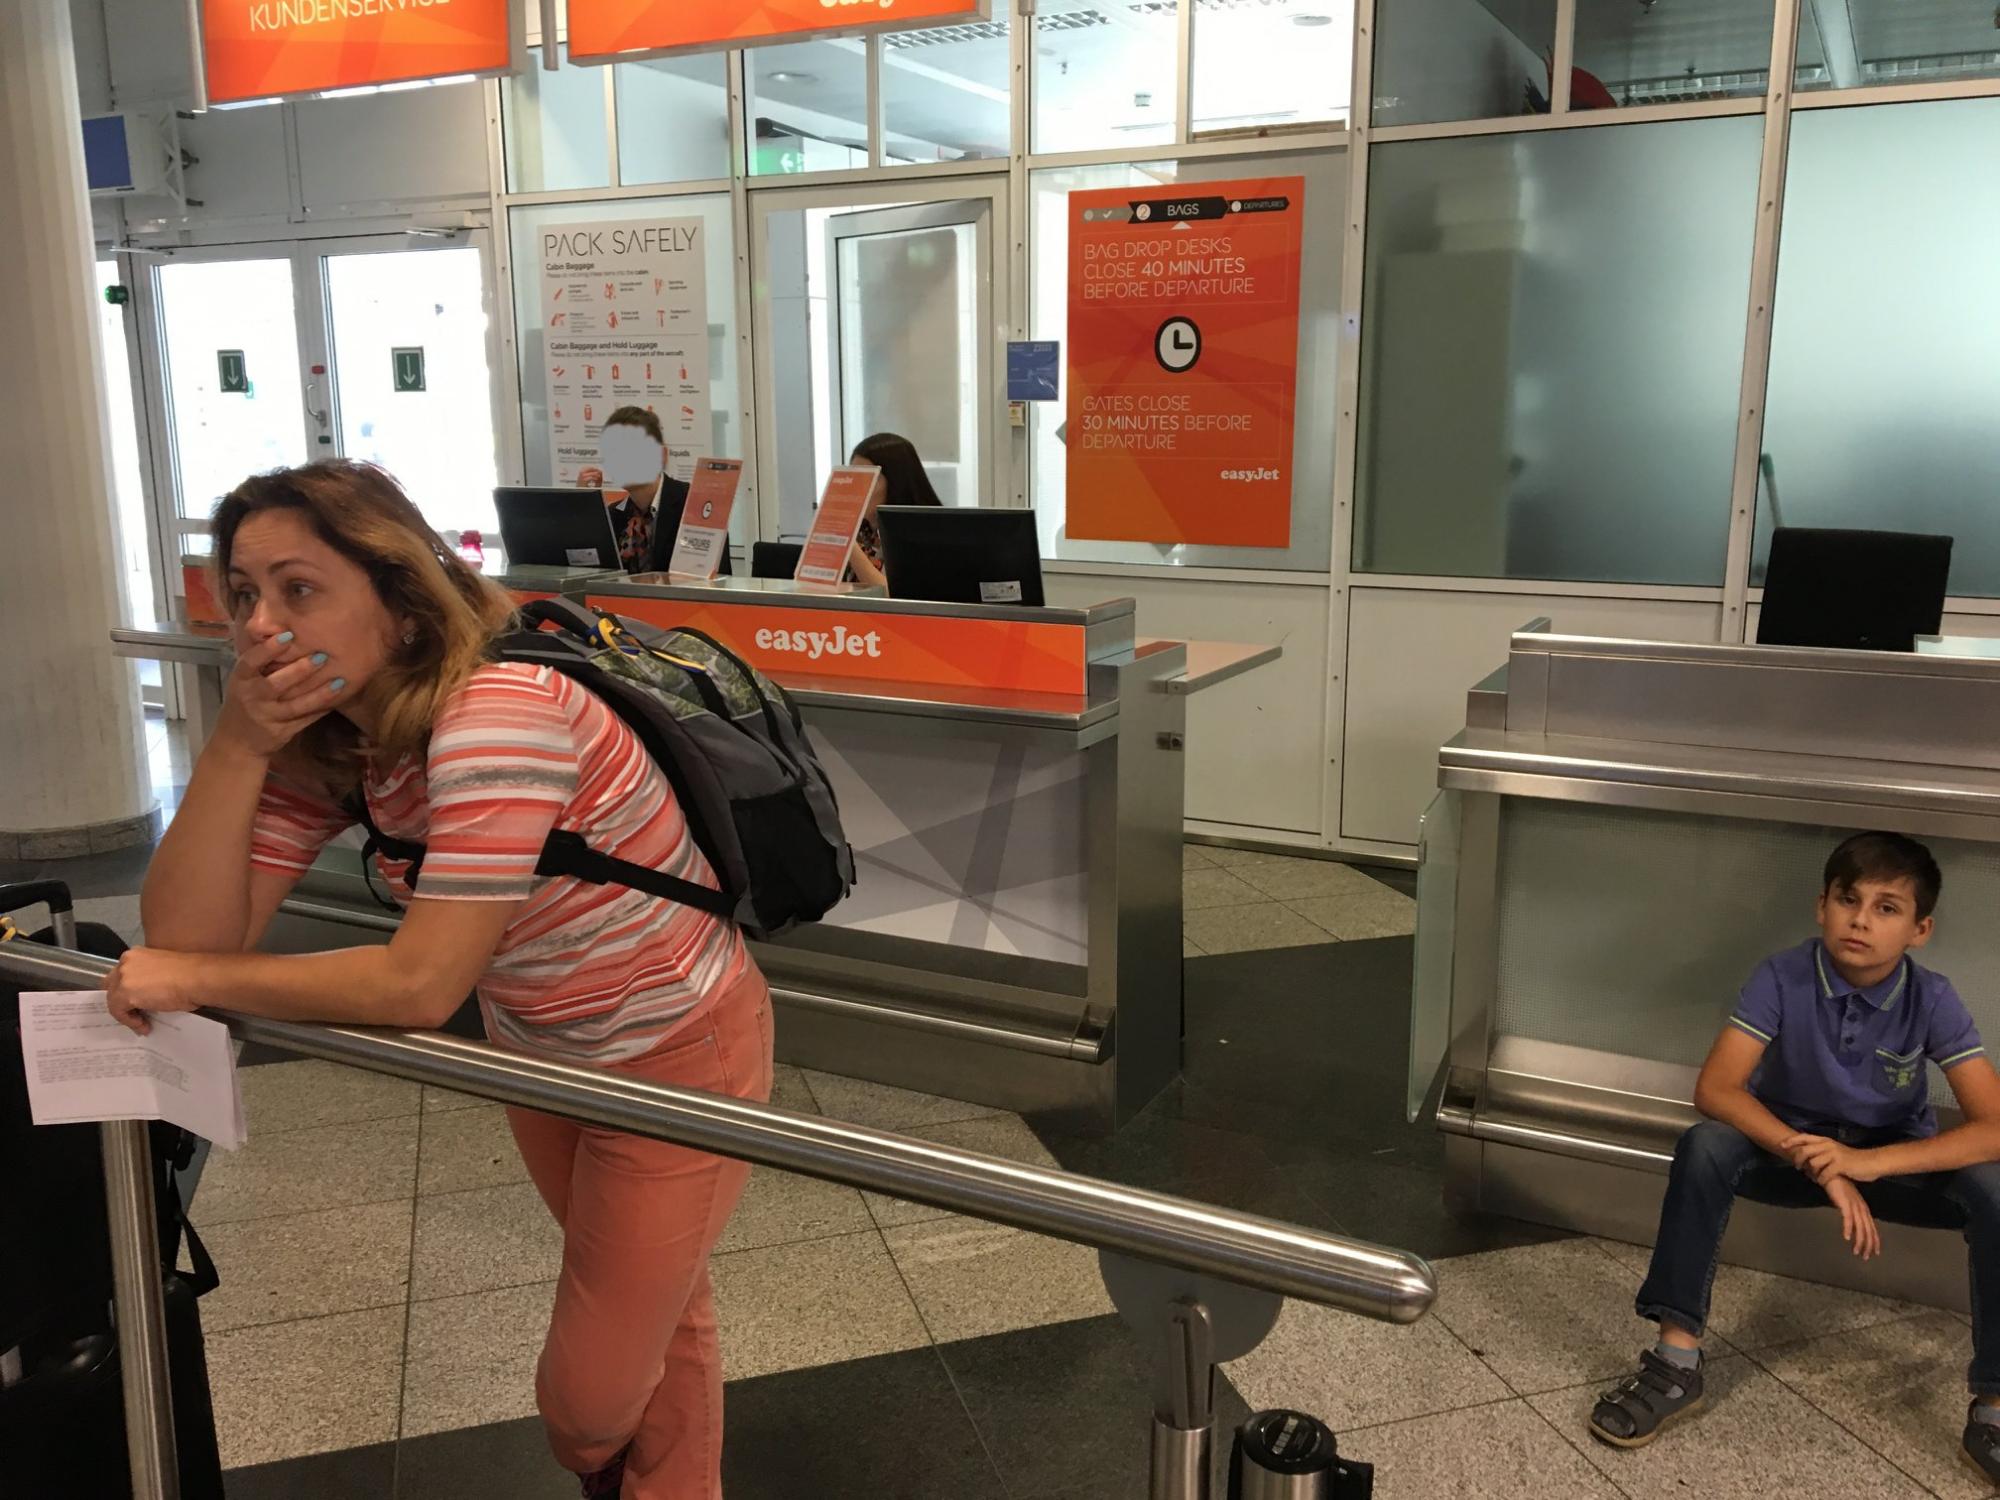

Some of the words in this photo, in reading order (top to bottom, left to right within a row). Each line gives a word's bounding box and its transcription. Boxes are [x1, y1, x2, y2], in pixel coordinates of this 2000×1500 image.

[249, 0, 451, 32] KUNDENSE
[1167, 203, 1200, 217] BAGS
[544, 231, 604, 257] PACK
[612, 226, 697, 255] SAFELY
[1084, 243, 1119, 260] BAG
[1124, 240, 1172, 258] DROP
[1176, 237, 1232, 256] DESKS
[1084, 262, 1136, 279] CLOSE
[1141, 260, 1164, 277] 40
[1168, 257, 1246, 276] MINUTES
[1084, 281, 1149, 299] BEFORE
[1154, 277, 1255, 297] DEPARTURE
[550, 342, 568, 350] Cabin
[569, 342, 597, 351] Baggage
[612, 341, 627, 349] Hold
[629, 341, 658, 350] Luggage
[1082, 395, 1134, 412] GATES
[1138, 395, 1191, 412] CLOSE
[1082, 415, 1103, 431] 30
[1107, 415, 1180, 431] MINUTES
[1184, 415, 1252, 431] BEFORE
[1082, 434, 1176, 450] DEPARTURE
[1220, 467, 1280, 482] easyJet
[755, 625, 881, 660] easyJet
